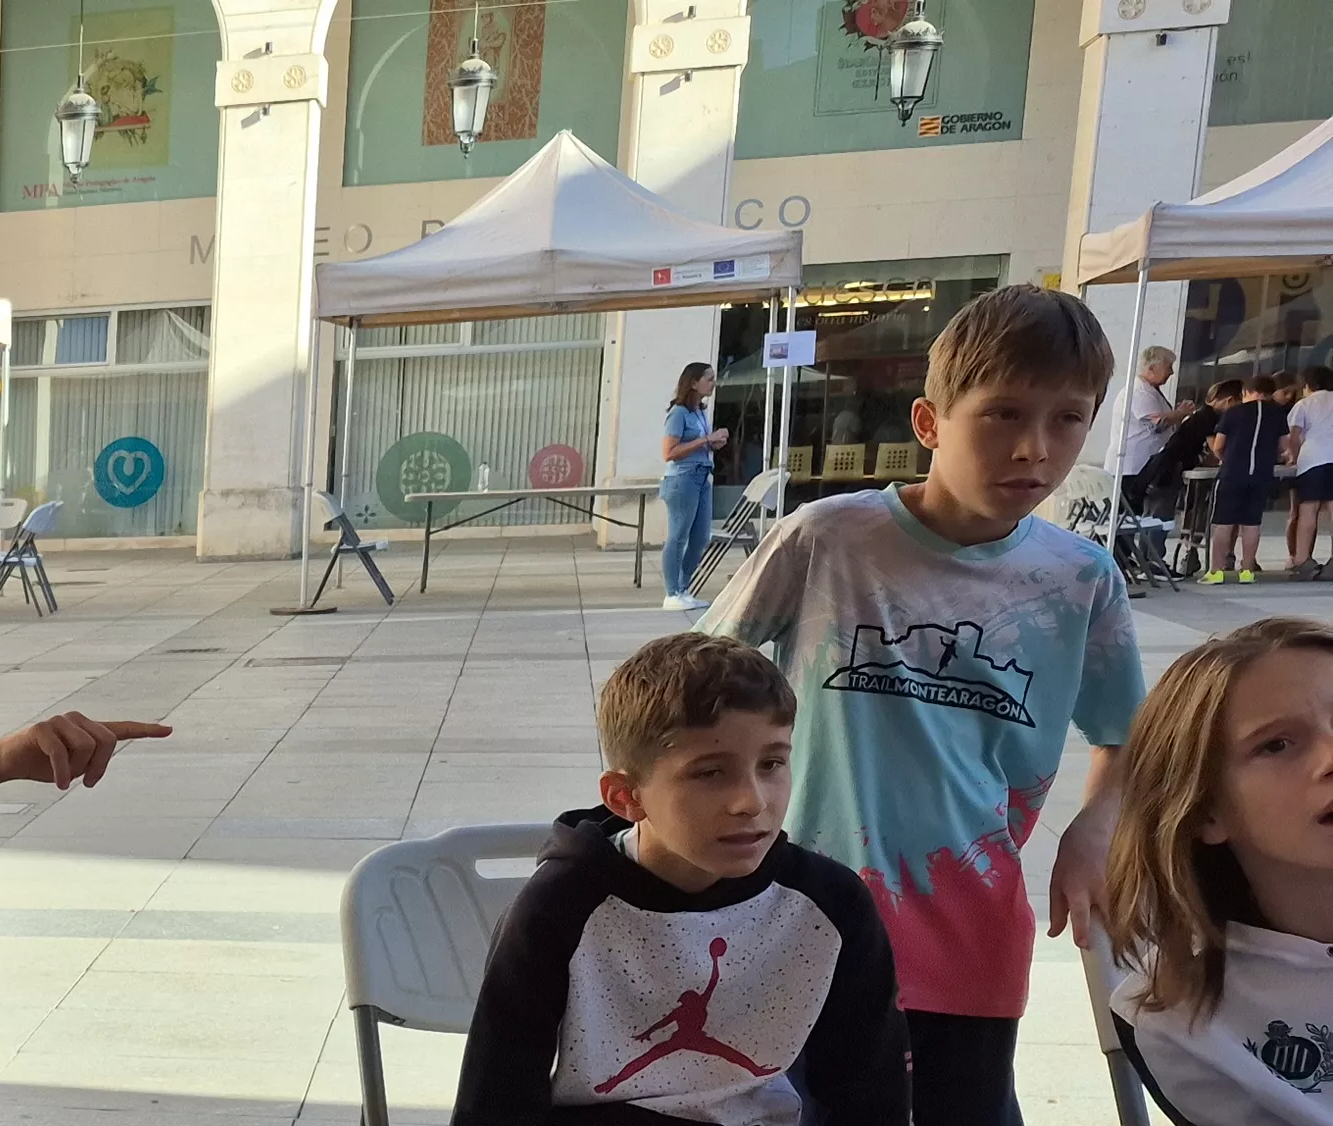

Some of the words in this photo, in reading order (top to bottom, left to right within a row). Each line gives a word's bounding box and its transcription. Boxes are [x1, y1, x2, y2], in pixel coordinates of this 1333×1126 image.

[941, 111, 1003, 125] GOBIERNO
[941, 125, 956, 135] DE
[800, 275, 937, 306] uesca
[849, 672, 1023, 719] TRAILMONTEARAGÓN
